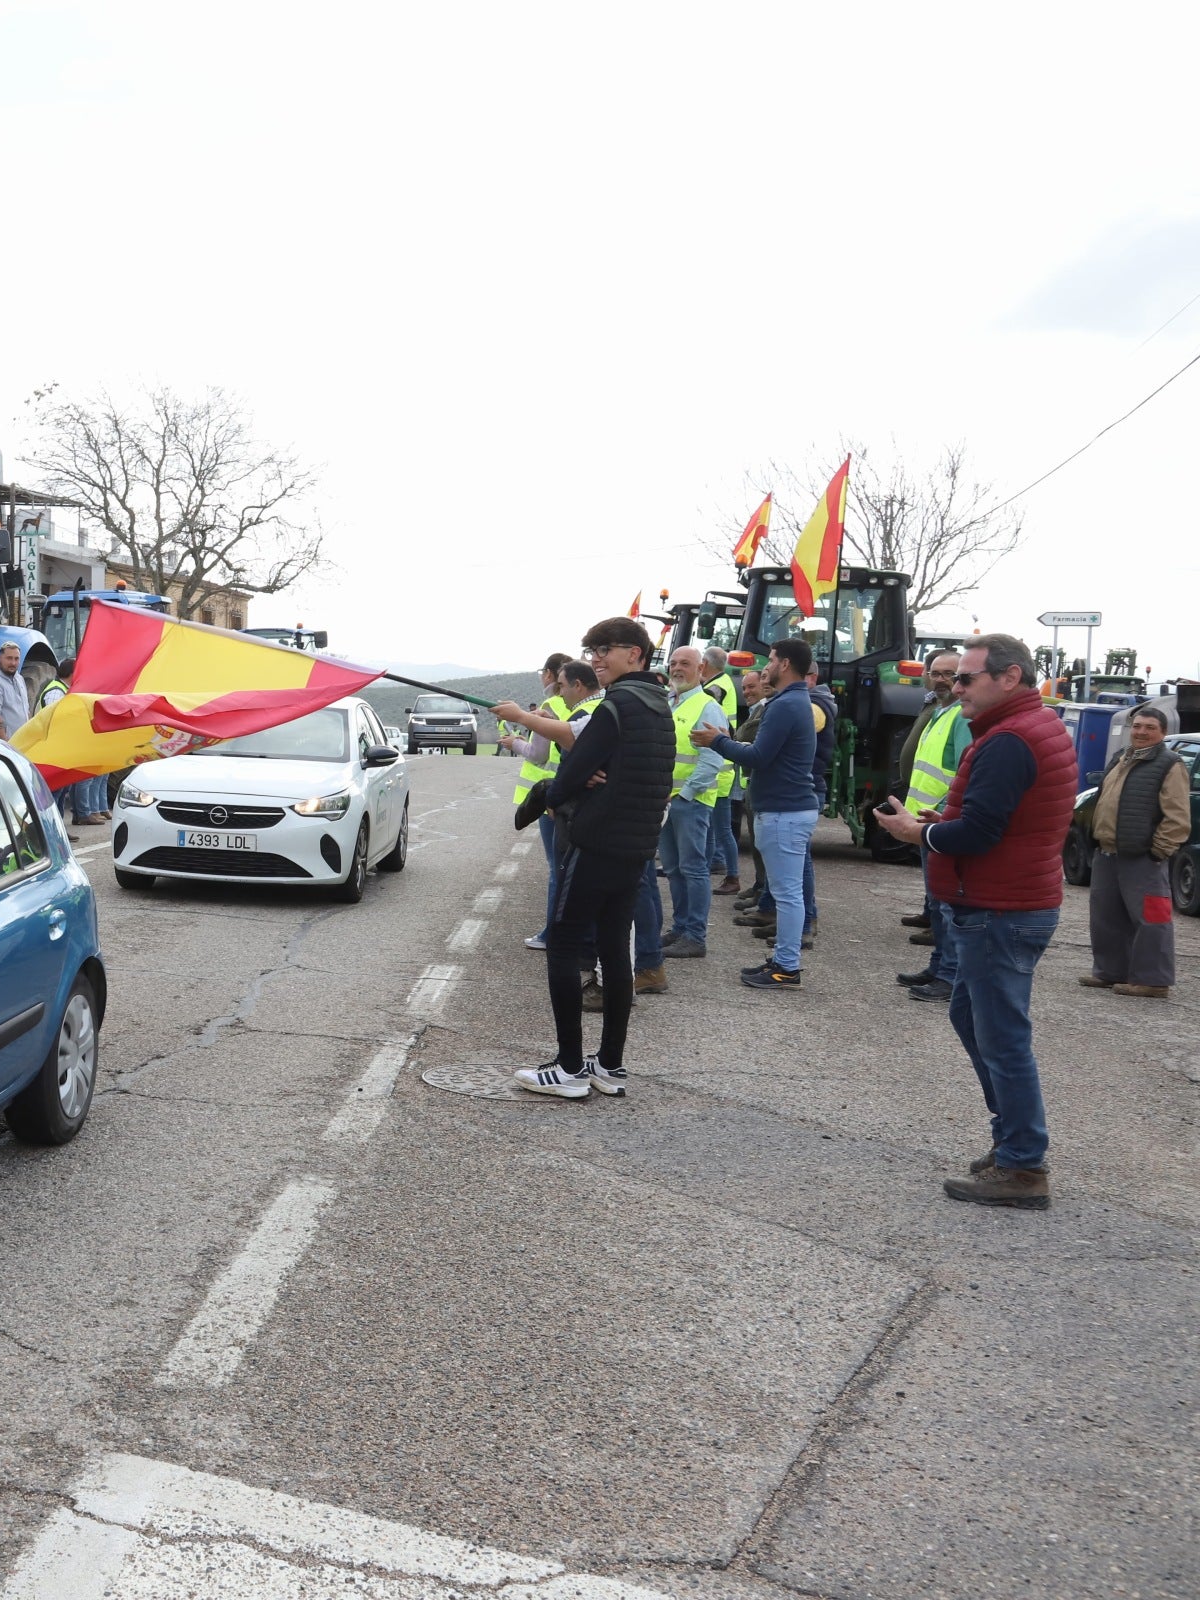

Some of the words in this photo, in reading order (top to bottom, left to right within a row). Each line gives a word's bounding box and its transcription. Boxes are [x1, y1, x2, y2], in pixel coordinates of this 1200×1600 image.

[28, 537, 36, 557] LA
[188, 833, 220, 848] 4393
[226, 835, 251, 849] LDL
